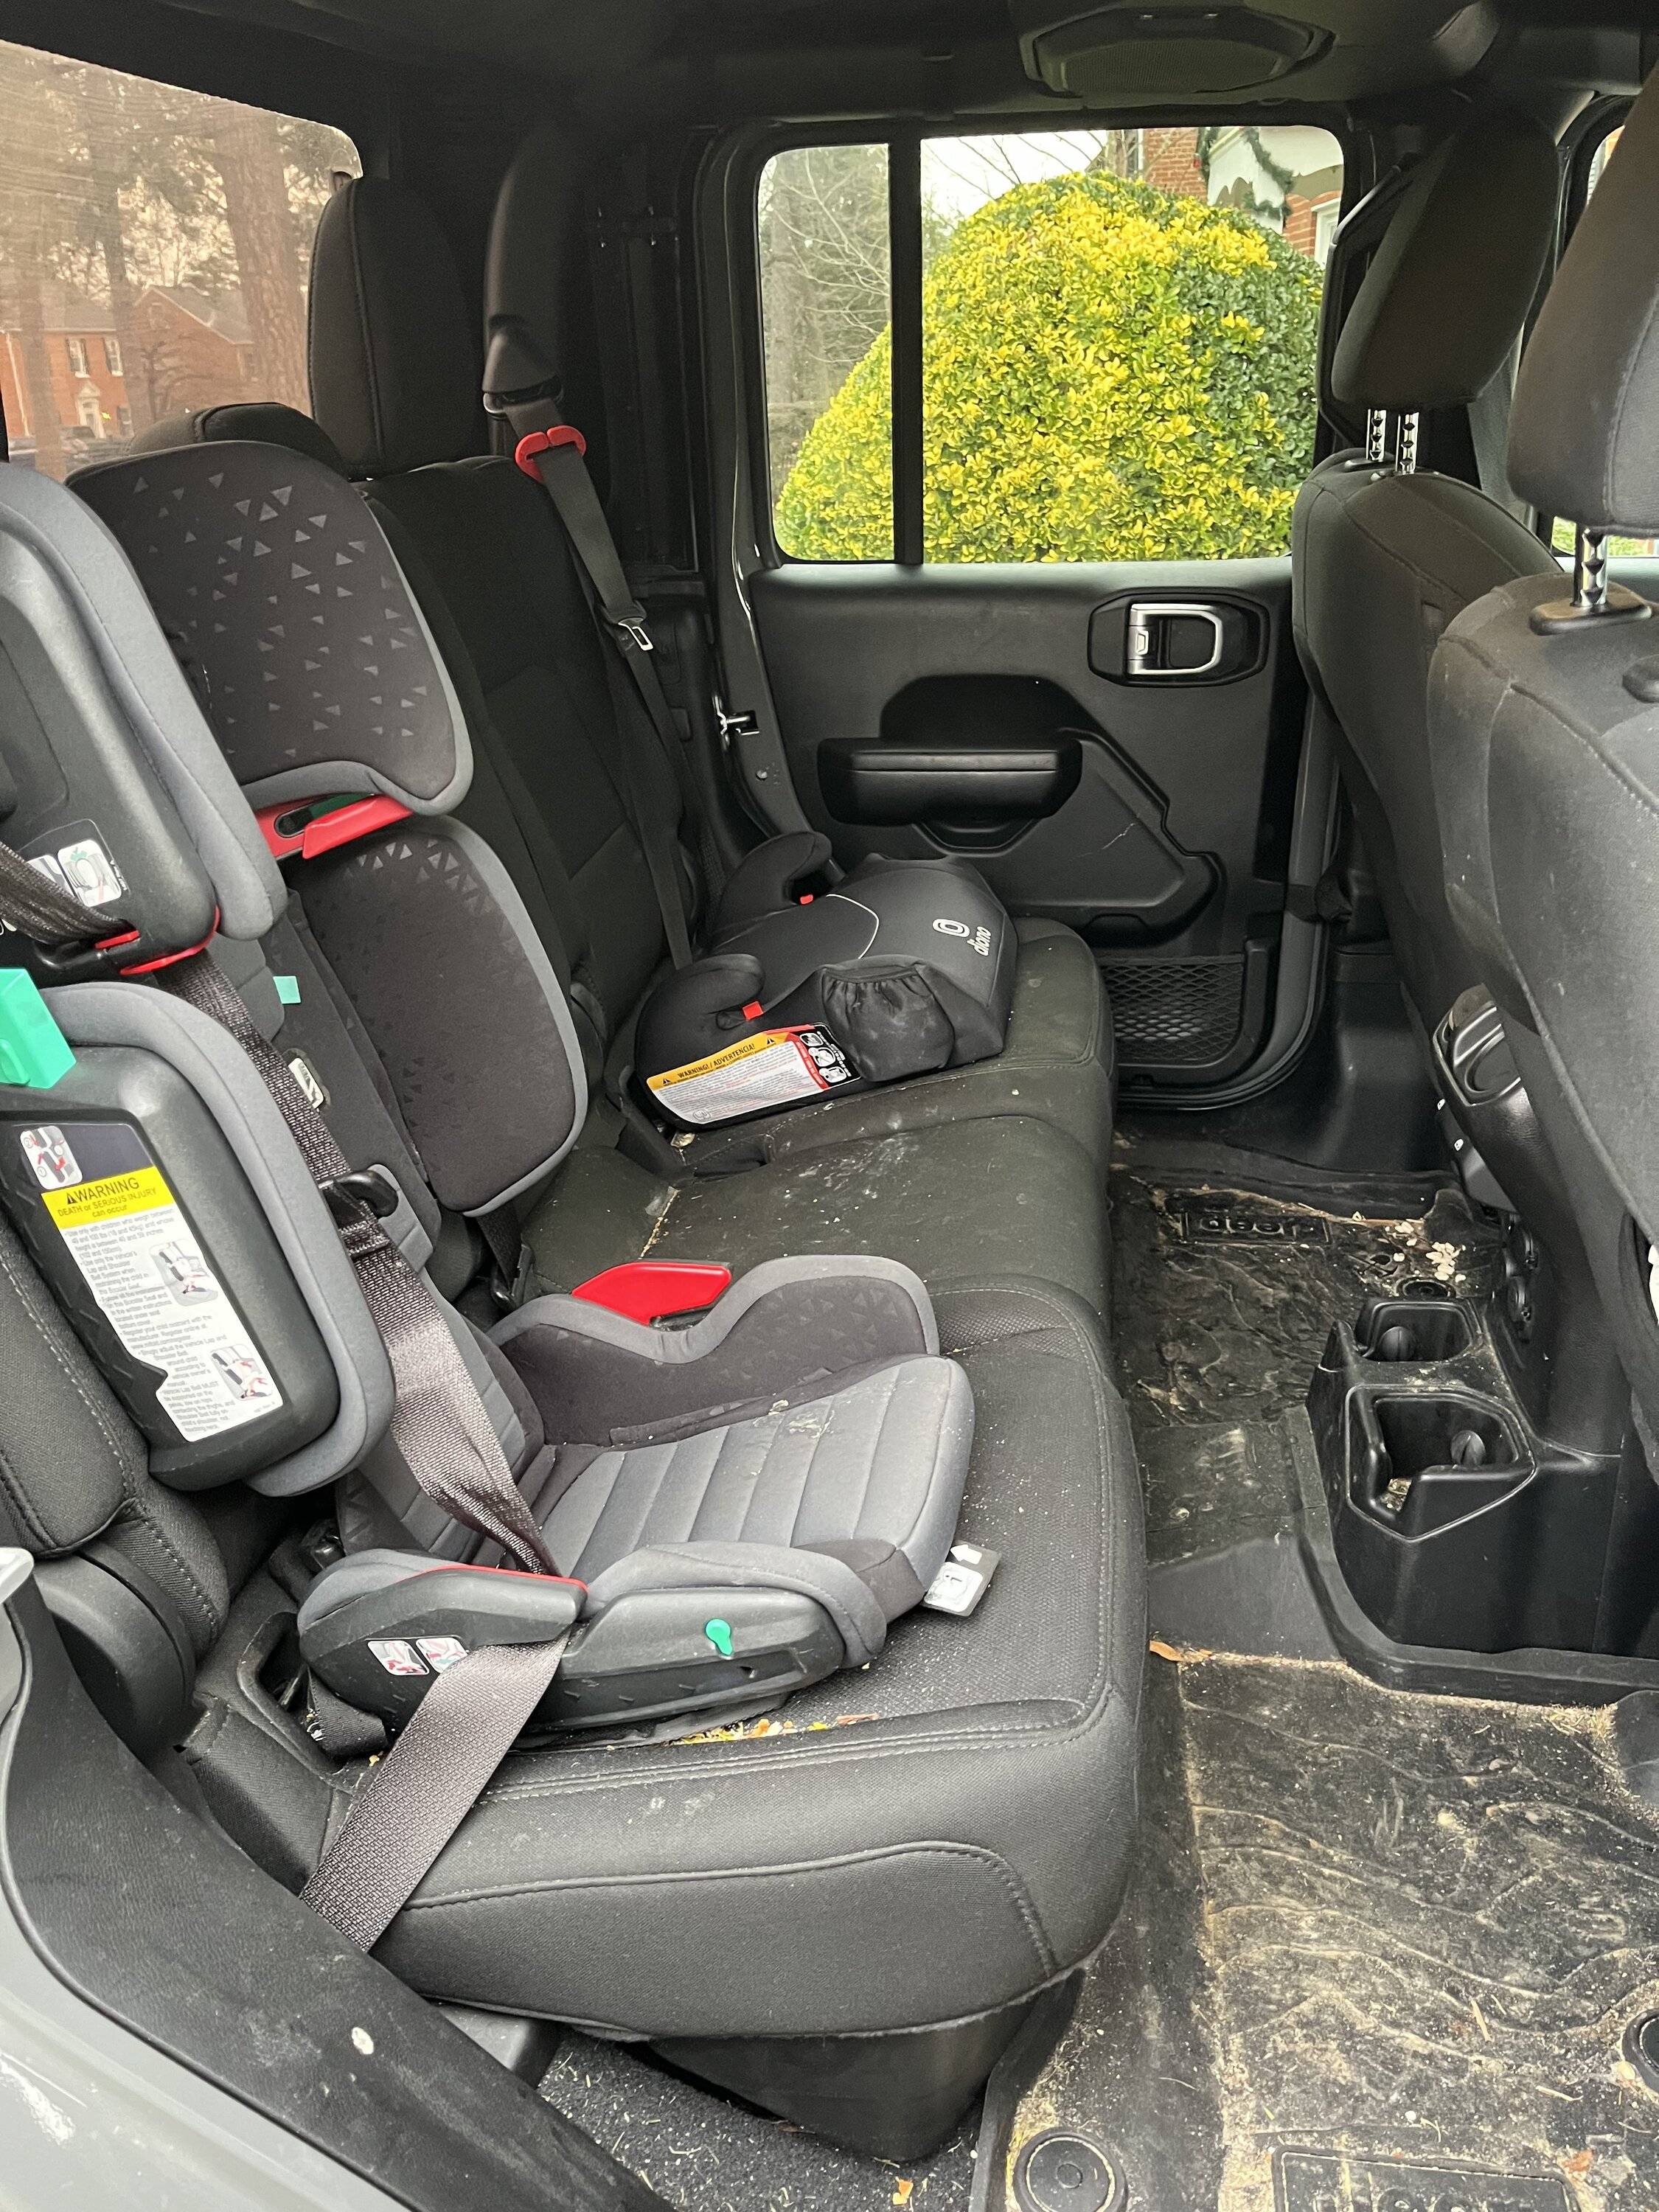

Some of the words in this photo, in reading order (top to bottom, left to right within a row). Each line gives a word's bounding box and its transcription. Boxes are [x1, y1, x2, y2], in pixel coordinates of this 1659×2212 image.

[967, 926, 991, 956] diono
[677, 1063, 709, 1079] WARNING!
[57, 1206, 83, 1217] DEATH
[92, 1194, 127, 1209] SERIOUS
[128, 1187, 156, 1201] INJURY
[74, 1178, 139, 1202] WARNING
[92, 1210, 105, 1218] can
[107, 1205, 127, 1214] occur
